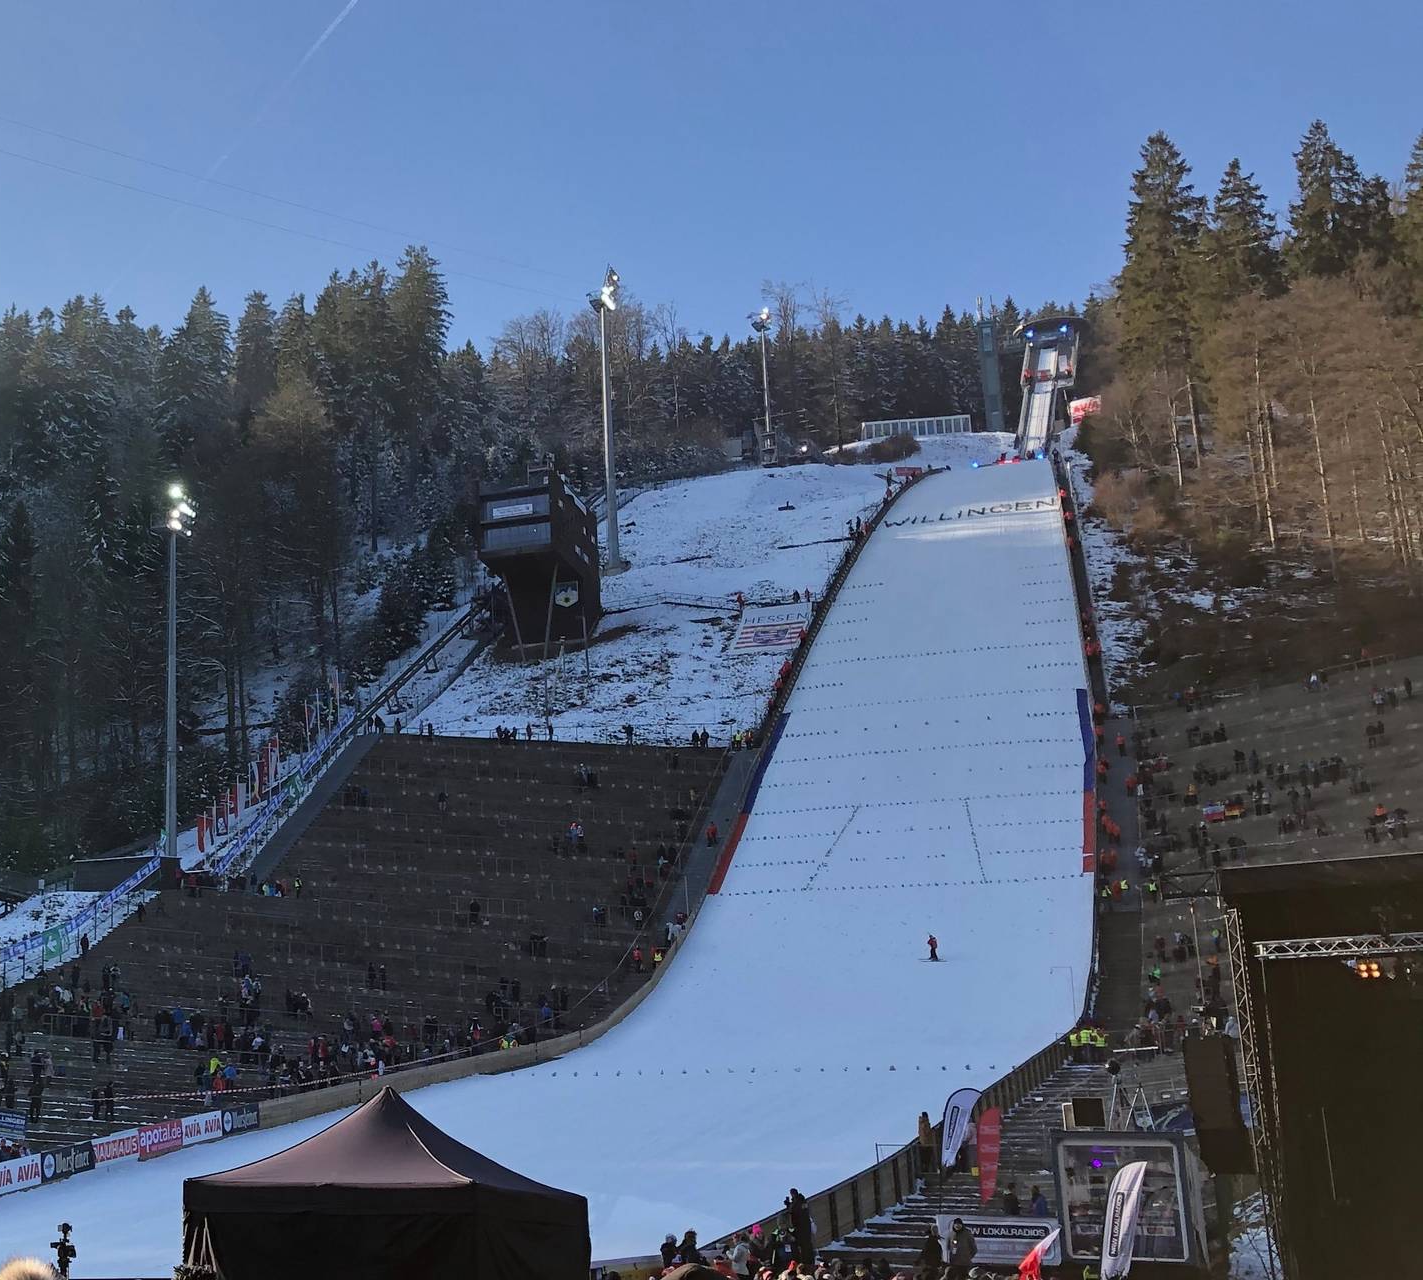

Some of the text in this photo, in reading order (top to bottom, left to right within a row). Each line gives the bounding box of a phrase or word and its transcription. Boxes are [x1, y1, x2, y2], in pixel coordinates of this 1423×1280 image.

[884, 497, 1055, 527] WILLINGEN
[745, 612, 808, 624] HESSEN
[140, 1122, 182, 1152] apotal.de
[184, 1115, 222, 1139] AVIA AVIA
[17, 1158, 41, 1183] AVIA
[982, 1228, 1046, 1237] LOKALRADIOS
